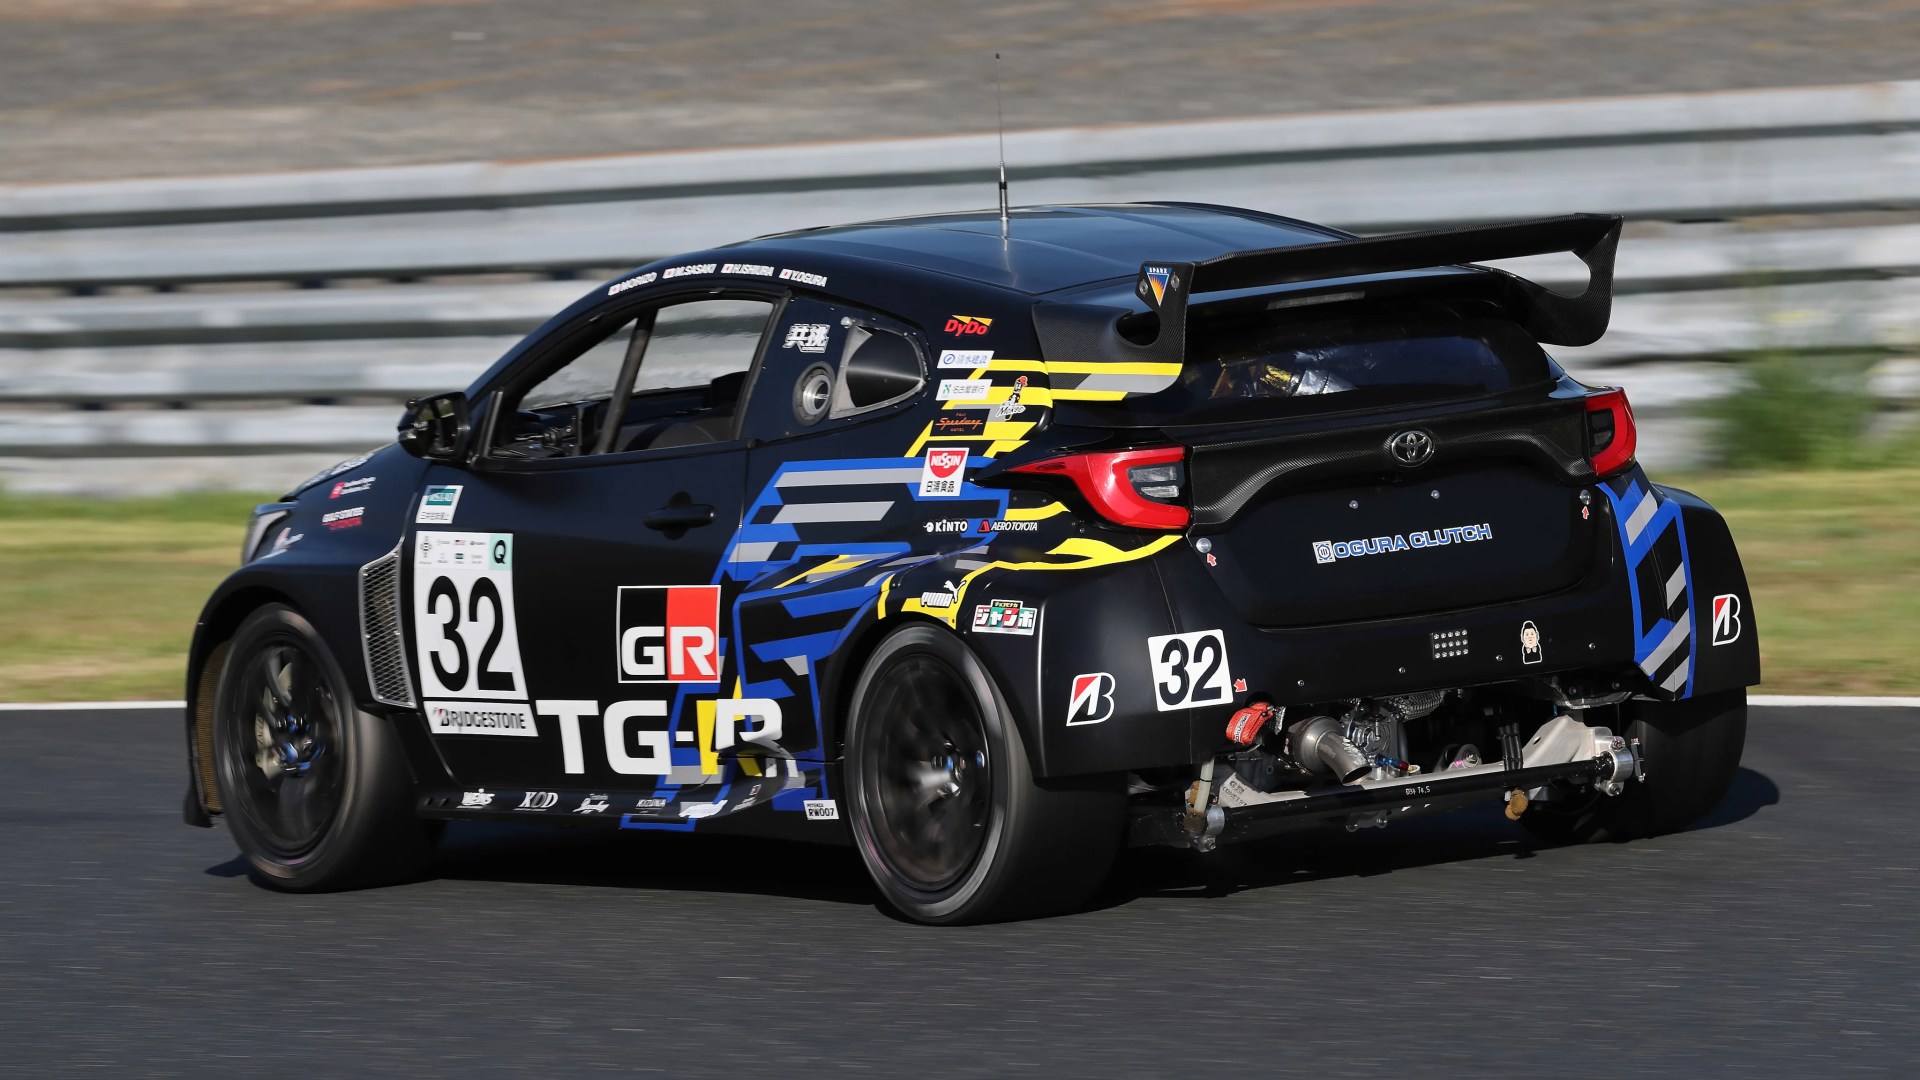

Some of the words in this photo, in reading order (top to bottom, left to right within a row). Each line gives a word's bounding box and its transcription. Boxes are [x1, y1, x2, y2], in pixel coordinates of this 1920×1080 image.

[944, 319, 988, 337] DyDo
[935, 417, 983, 431] Speedway
[931, 452, 962, 468] NISSIN
[494, 539, 506, 564] Q
[1332, 534, 1410, 559] OGURA
[1409, 523, 1493, 549] CLUTCH
[975, 607, 1034, 628] ジャンボ
[427, 575, 516, 692] 32
[621, 626, 716, 676] GR
[1158, 635, 1223, 706] 32
[434, 706, 526, 729] BRIDGESTONE
